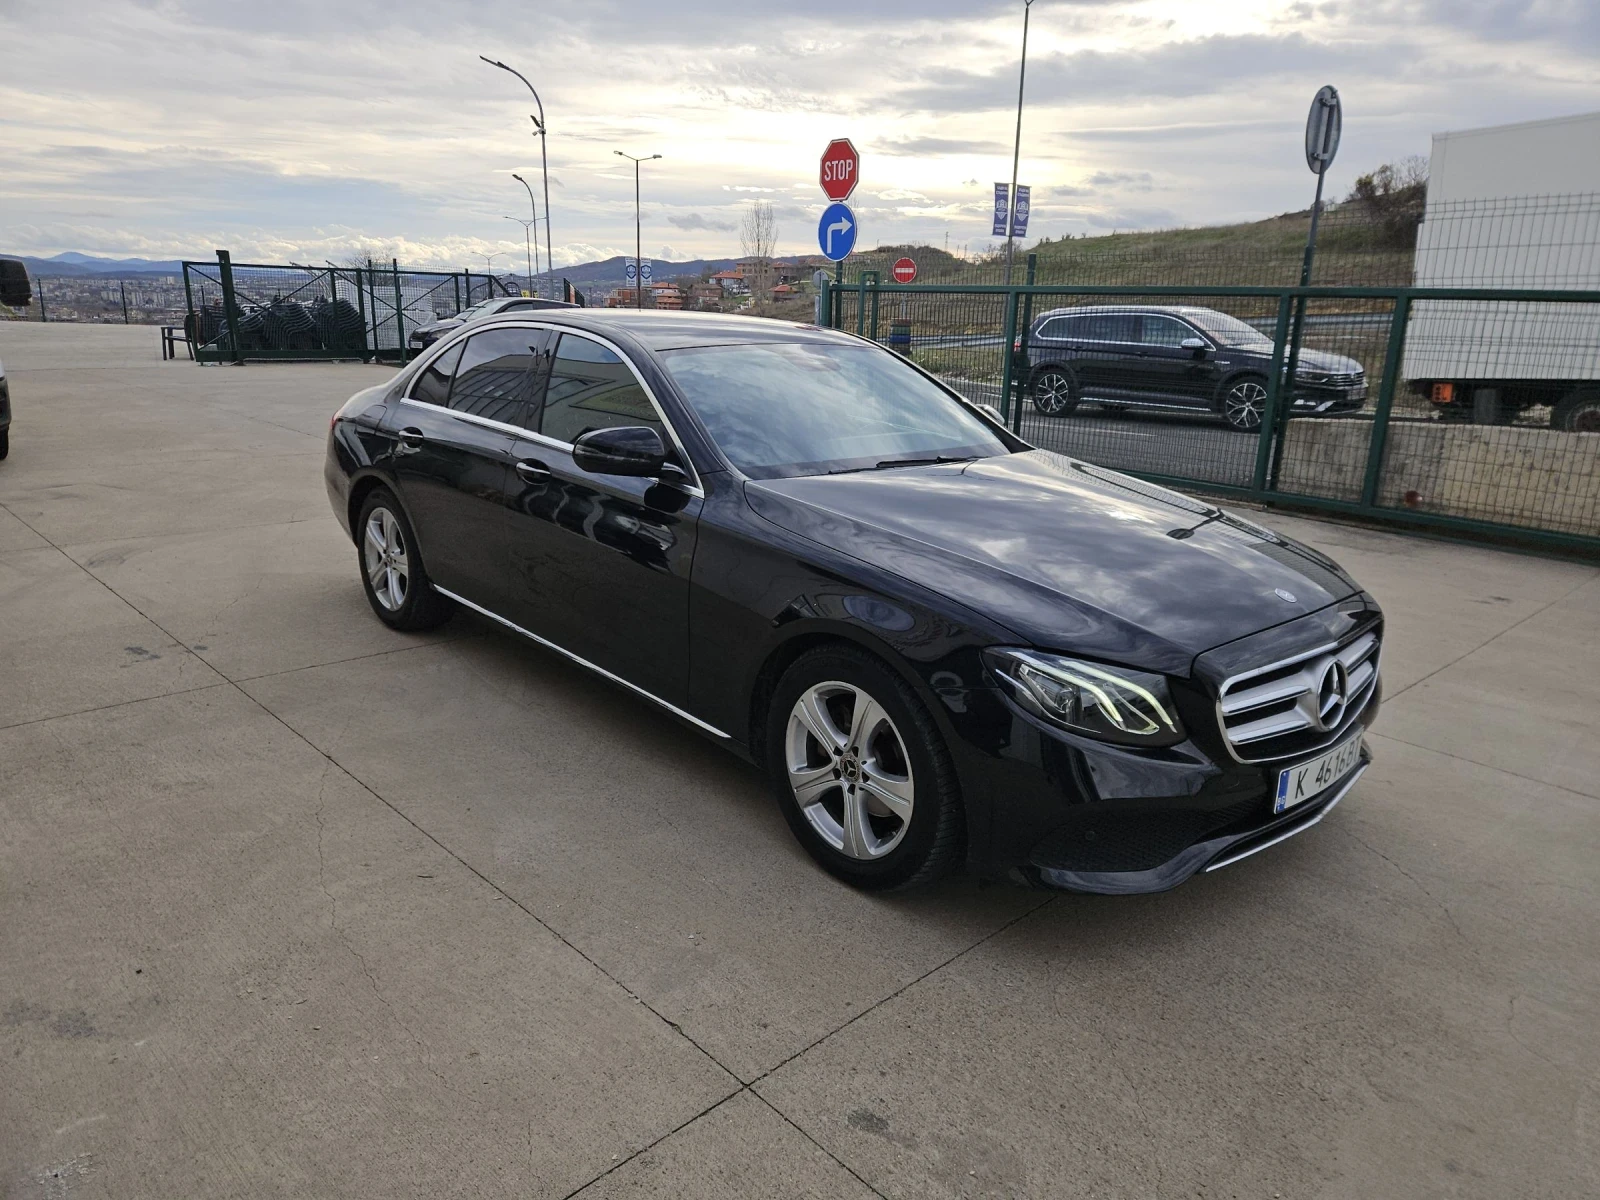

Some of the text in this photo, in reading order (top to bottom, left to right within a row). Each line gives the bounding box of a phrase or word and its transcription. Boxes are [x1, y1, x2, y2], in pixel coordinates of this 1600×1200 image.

[825, 160, 853, 181] STOP
[1295, 768, 1308, 799] K
[1277, 796, 1286, 806] BG
